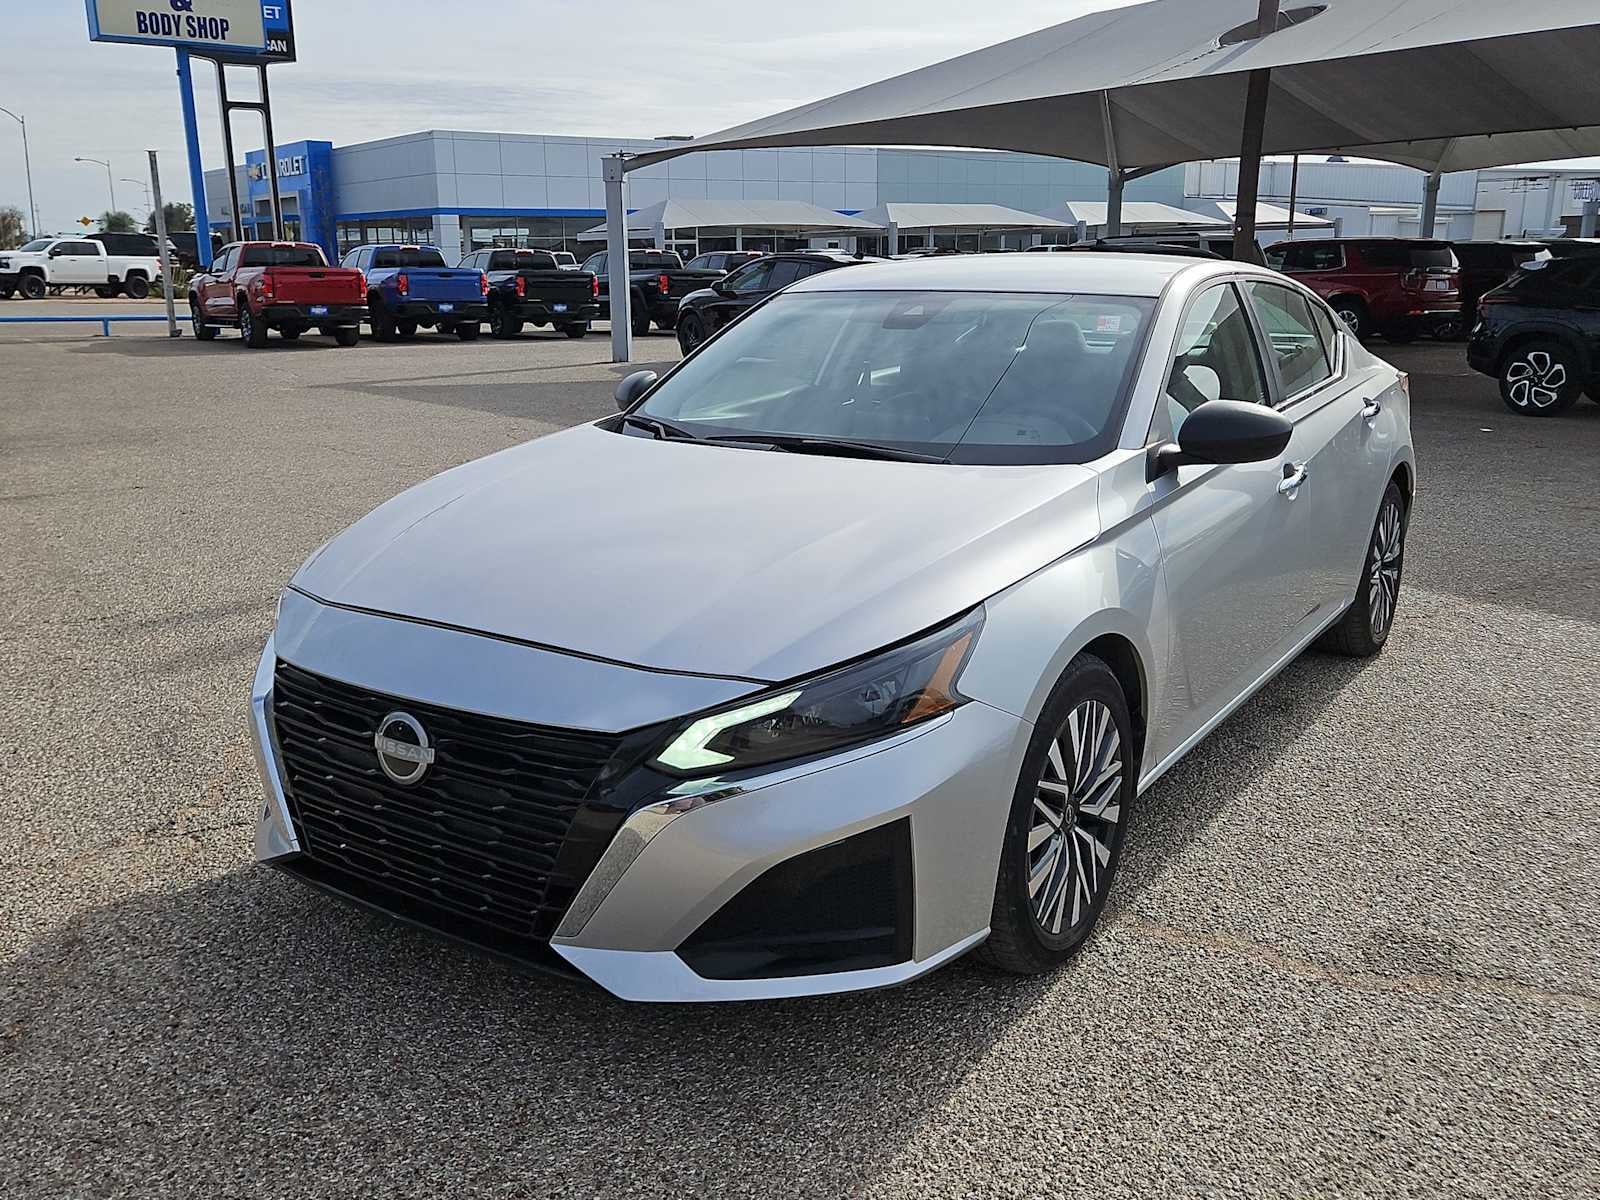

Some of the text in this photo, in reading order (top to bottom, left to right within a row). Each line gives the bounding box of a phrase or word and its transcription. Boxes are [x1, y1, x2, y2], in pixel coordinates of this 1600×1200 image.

[136, 11, 229, 40] BODY SHOP
[261, 155, 303, 179] CROLET
[376, 735, 433, 761] NISSAN
